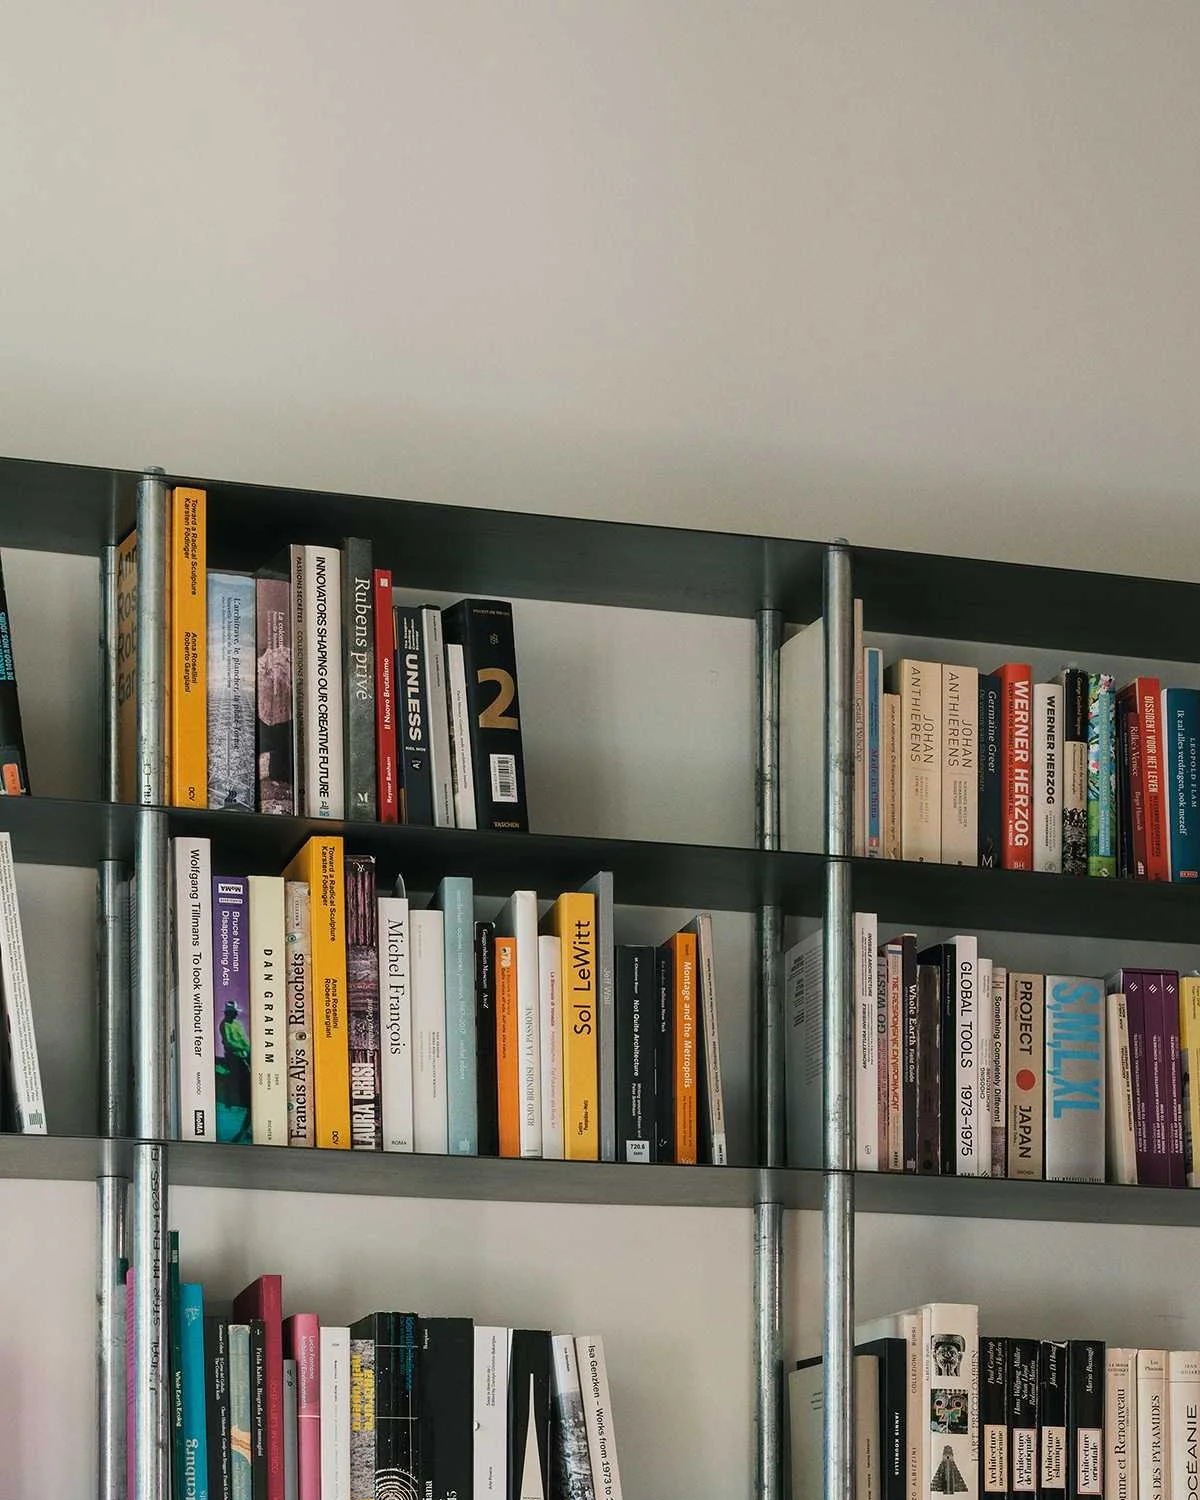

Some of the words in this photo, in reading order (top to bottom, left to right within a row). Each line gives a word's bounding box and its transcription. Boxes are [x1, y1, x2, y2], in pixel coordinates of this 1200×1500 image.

[315, 557, 327, 626] INNOVATORS
[355, 578, 371, 646] Rubens
[317, 628, 328, 677] SHAPING
[351, 652, 373, 699] privé
[318, 678, 328, 703] OUR
[406, 654, 422, 741] UNLESS
[477, 668, 518, 730] 2
[318, 705, 328, 755] CREATIVE
[948, 672, 959, 767] ANTHIERENS
[1014, 681, 1028, 762] WERNER
[1046, 696, 1056, 750] WERNER
[962, 720, 972, 768] JOHAN
[318, 756, 329, 797] FUTURE
[1046, 753, 1055, 804] HERZOG
[1015, 768, 1029, 846] HERZOG
[188, 850, 199, 899] Wolfgang
[190, 903, 201, 946] Tillmans
[221, 911, 230, 964] Disappearing
[232, 912, 240, 935] Bruce
[193, 952, 202, 965] To
[232, 938, 240, 972] Nauman
[264, 949, 273, 982] DAN
[388, 920, 403, 976] Michel
[573, 921, 591, 991] LeWitt
[192, 967, 203, 990] look
[289, 954, 305, 1024] Ricochets
[682, 962, 692, 1001] Montage
[961, 962, 972, 1016] GLOBAL
[193, 993, 203, 1032] without
[265, 991, 274, 1063] GRAHAM
[386, 984, 405, 1054] François
[574, 1005, 591, 1035] Sol
[684, 1003, 692, 1020] and
[684, 1022, 692, 1037] the
[1019, 981, 1032, 1055] PROJECT
[194, 1036, 204, 1057] fear
[683, 1040, 692, 1088] Metropolis
[961, 1023, 972, 1068] TOOLS
[1046, 982, 1101, 1119] S,M,L,XL
[292, 1084, 307, 1138] Francis
[1019, 1105, 1032, 1158] JAPAN
[588, 1345, 597, 1358] Isa
[589, 1361, 601, 1398] Genzken
[596, 1409, 605, 1436] Works
[599, 1438, 609, 1458] from
[602, 1462, 612, 1484] 1973
[605, 1487, 612, 1495] to
